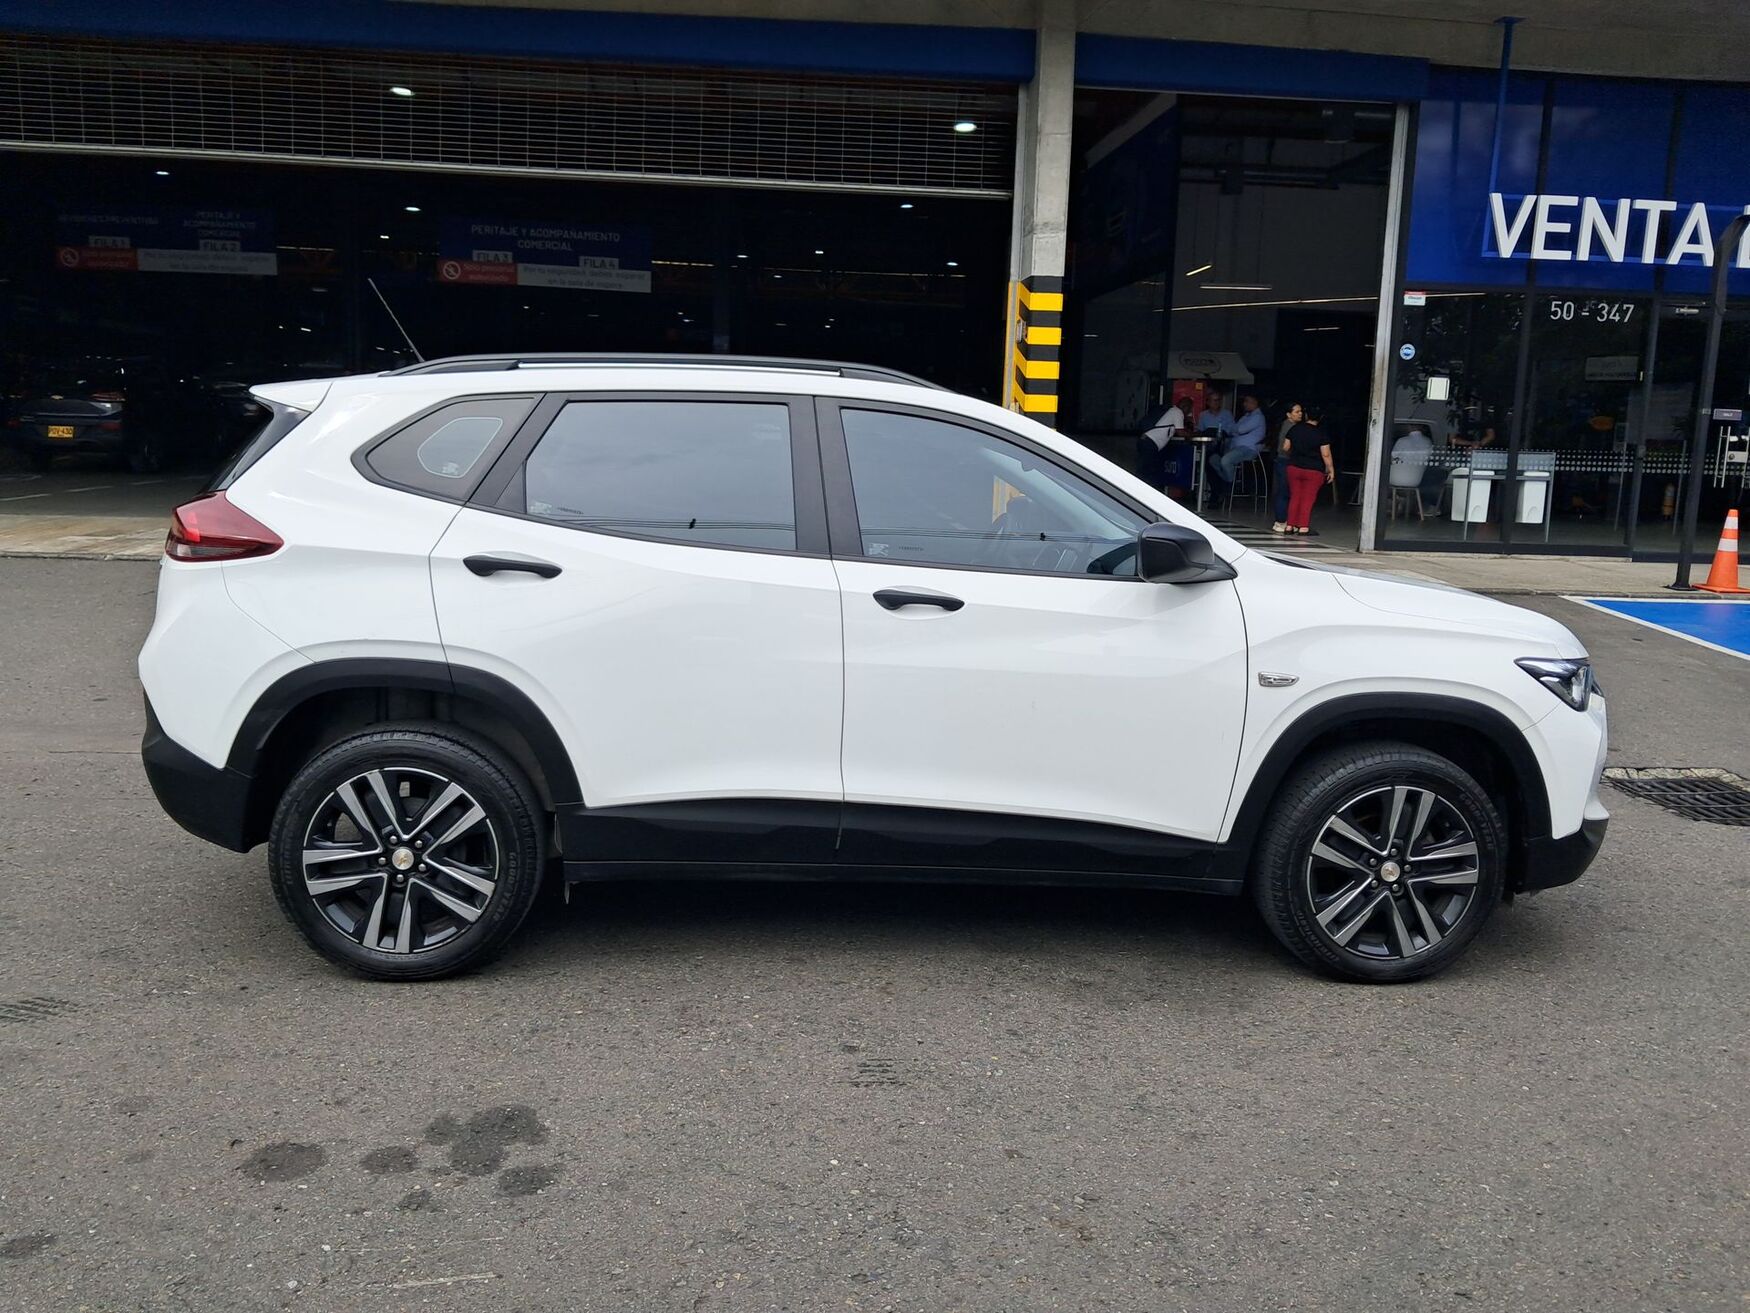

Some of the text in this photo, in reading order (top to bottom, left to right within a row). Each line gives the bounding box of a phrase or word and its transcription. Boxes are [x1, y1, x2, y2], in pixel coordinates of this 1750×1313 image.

[471, 224, 518, 236] PERITAJE
[521, 228, 527, 237] Y
[1489, 192, 1715, 267] VENTA
[517, 239, 574, 251] COMERCIAL
[583, 258, 605, 269] FILA
[1551, 302, 1574, 319] 50
[1597, 304, 1635, 322] 347
